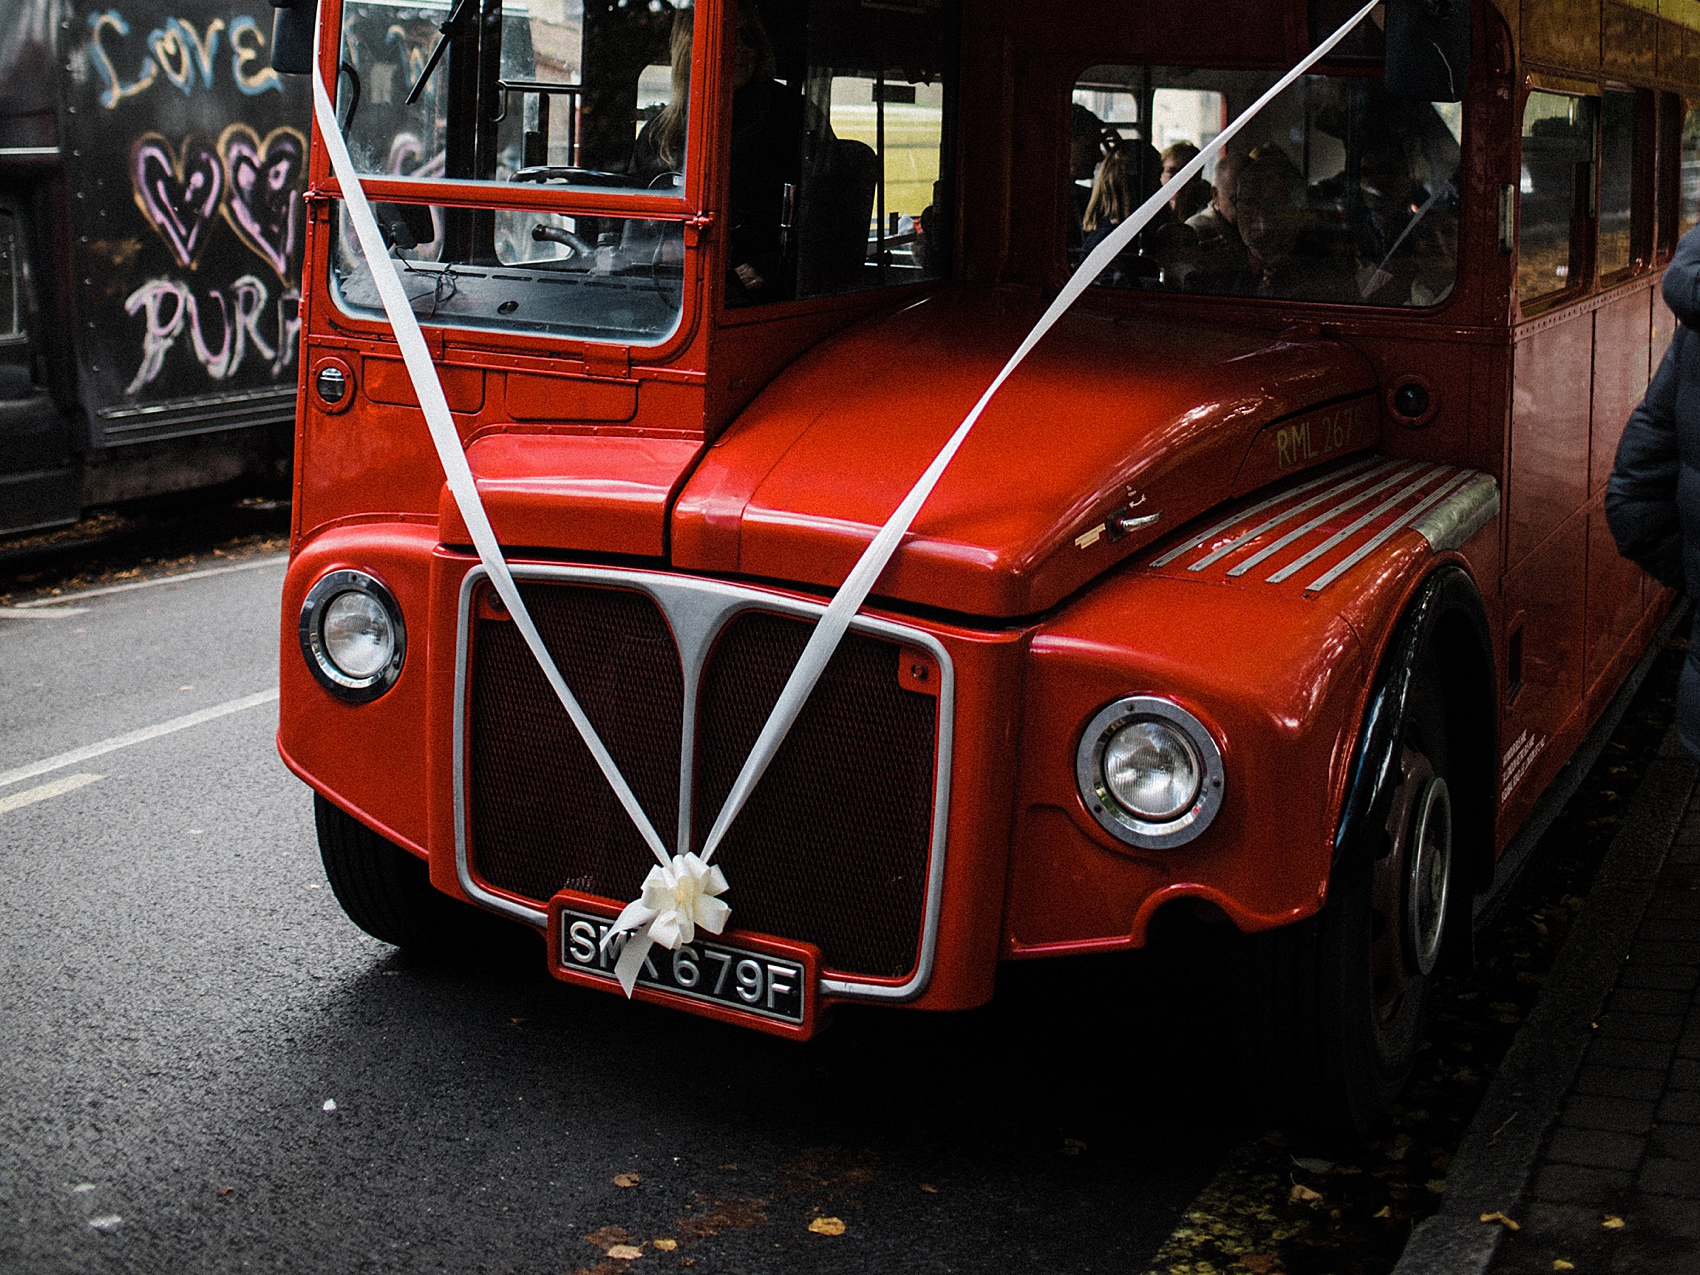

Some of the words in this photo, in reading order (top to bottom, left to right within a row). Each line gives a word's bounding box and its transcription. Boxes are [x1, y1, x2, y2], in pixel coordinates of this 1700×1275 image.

[89, 9, 283, 110] LOVE
[1276, 422, 1318, 469] RML
[672, 946, 797, 1008] 679F
